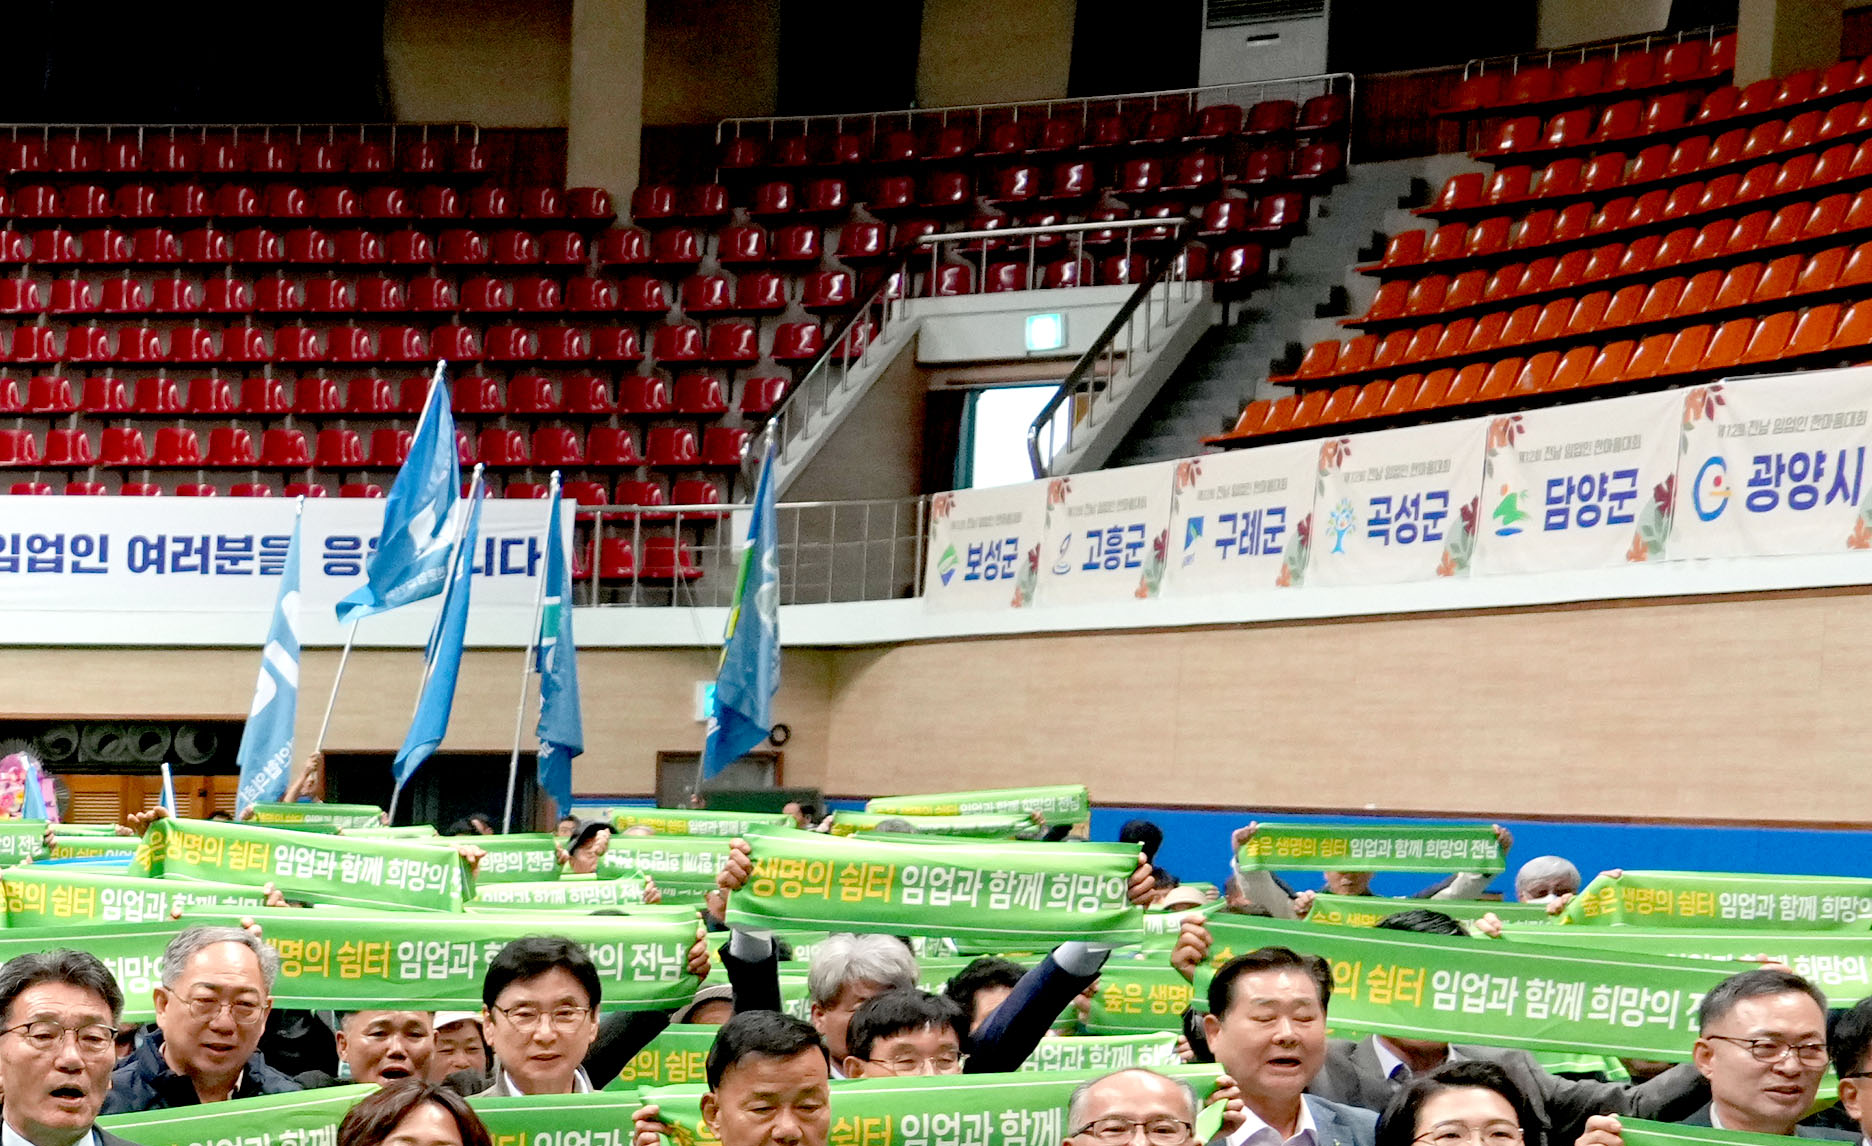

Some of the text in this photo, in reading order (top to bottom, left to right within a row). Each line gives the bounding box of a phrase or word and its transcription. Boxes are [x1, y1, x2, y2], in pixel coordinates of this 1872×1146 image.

[1748, 419, 1770, 436] 전남
[1773, 416, 1808, 435] 임업인
[1810, 411, 1867, 432] 한마음대회
[1544, 467, 1639, 532] 담양군
[1745, 447, 1865, 512] 광양시
[1215, 506, 1287, 560] 구례군
[1367, 490, 1449, 547] 곡성군
[964, 537, 1019, 582] 보성군
[1081, 523, 1145, 572] 고흥군
[1275, 836, 1498, 860] 생명의 쉼터 임업과 함께 희망의 전남
[1367, 964, 1679, 1030] 쉼터 임업과 함께 희망의
